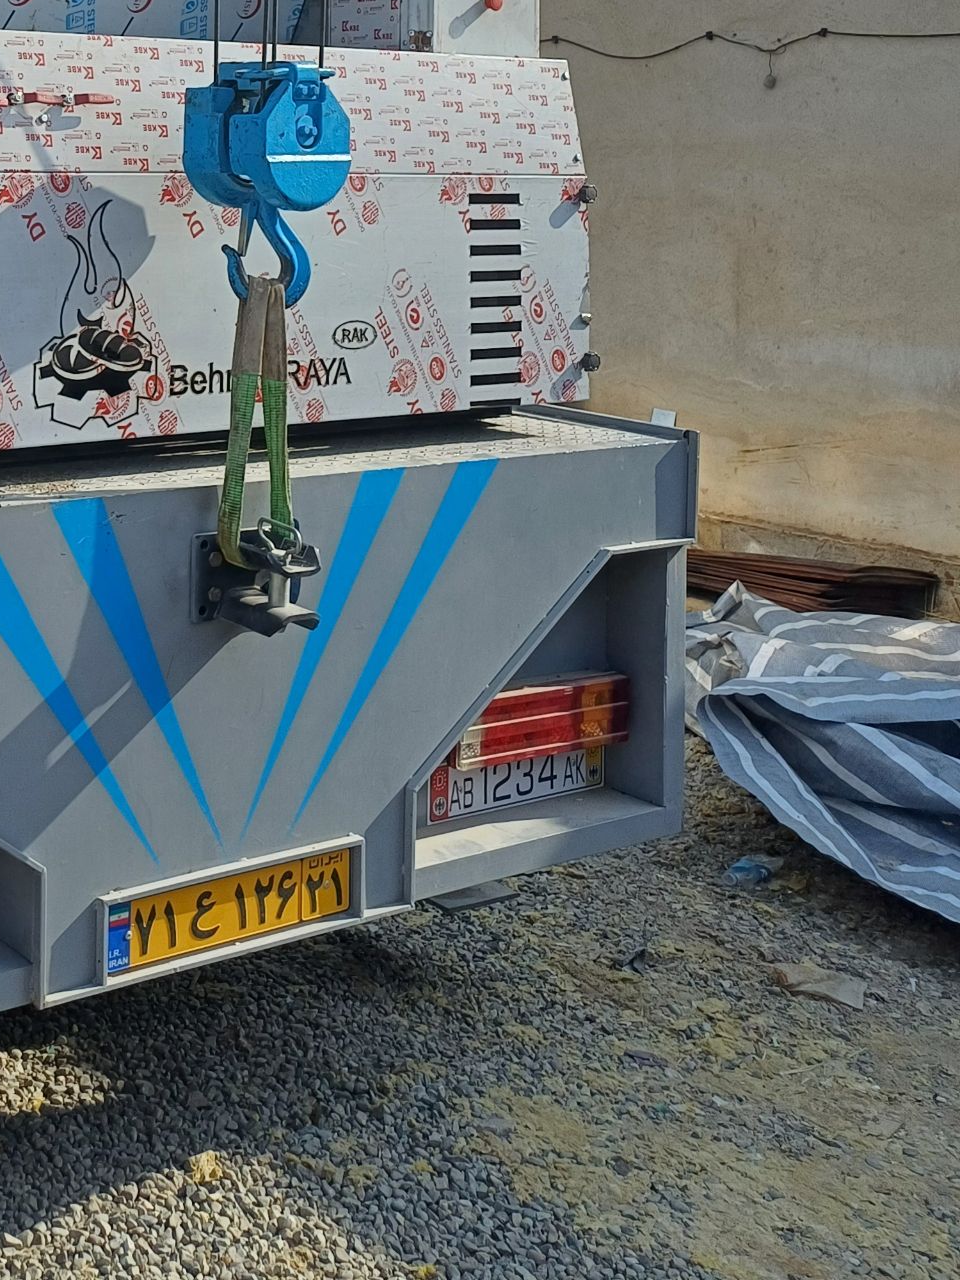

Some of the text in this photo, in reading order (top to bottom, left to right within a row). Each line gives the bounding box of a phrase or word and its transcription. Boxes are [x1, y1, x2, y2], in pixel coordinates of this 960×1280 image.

[87, 12, 95, 34] STEE
[22, 212, 46, 242] DY
[182, 210, 204, 238] DY
[326, 210, 346, 236] DY
[543, 278, 560, 313] STEEL
[137, 294, 157, 332] STEEL
[340, 327, 369, 343] RAK
[374, 306, 400, 358] STEEL
[420, 283, 462, 378] STAINLESS STEEL
[169, 362, 231, 397] Beh
[449, 778, 473, 812] AB
[480, 754, 557, 805] 1234
[563, 753, 585, 787] AK
[108, 958, 129, 968] IRAN
